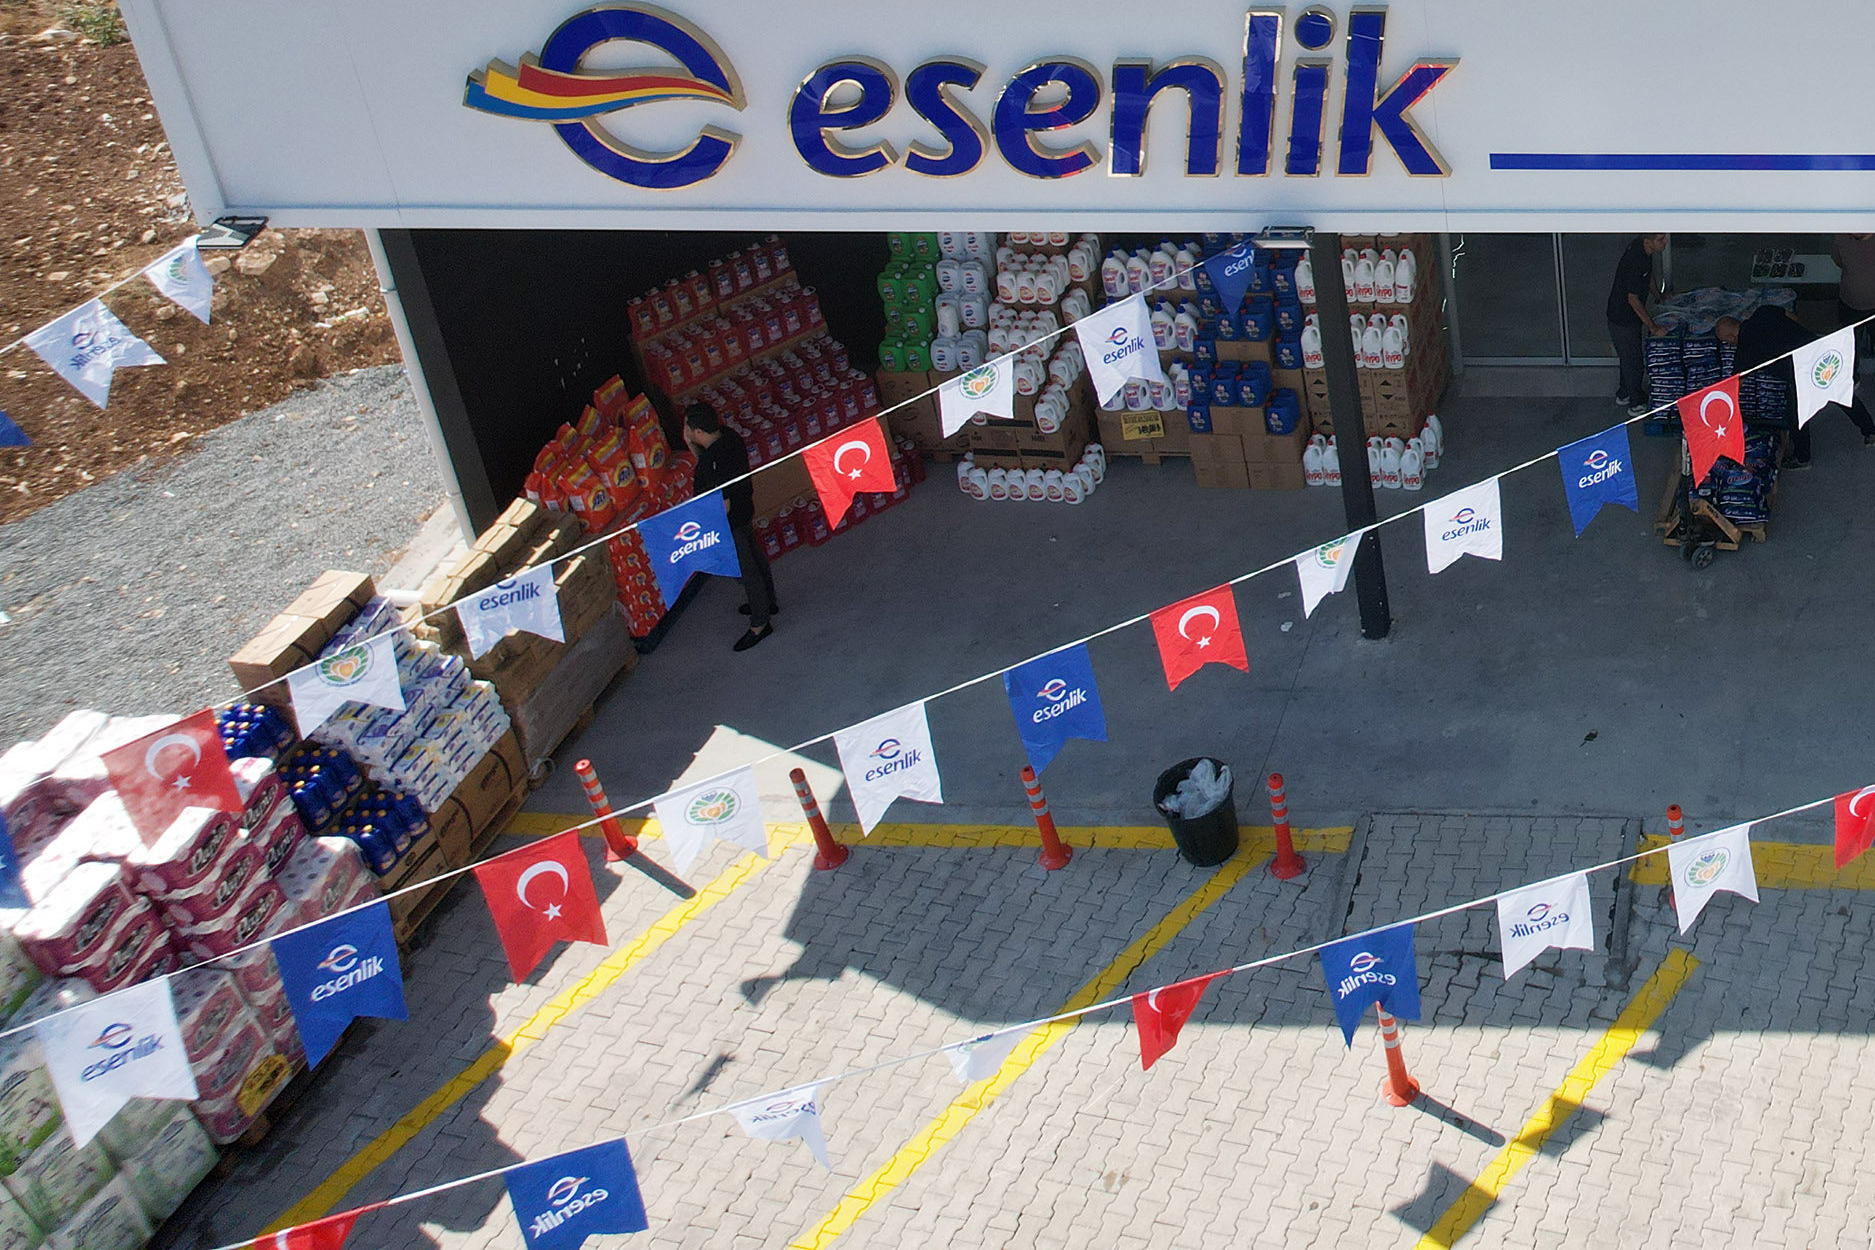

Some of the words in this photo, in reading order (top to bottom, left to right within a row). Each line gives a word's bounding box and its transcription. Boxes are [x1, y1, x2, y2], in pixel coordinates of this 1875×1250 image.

[787, 4, 1462, 180] esenlik
[1103, 335, 1145, 364] esenlik
[1579, 458, 1623, 488] esenlik
[1442, 517, 1491, 541] esenlik
[670, 531, 720, 564] esenlik
[479, 582, 541, 611] esenlik
[1032, 686, 1087, 724] esenlik
[864, 753, 922, 783] esenlik
[311, 953, 384, 1002] esenlik
[81, 1032, 165, 1082] esenlik
